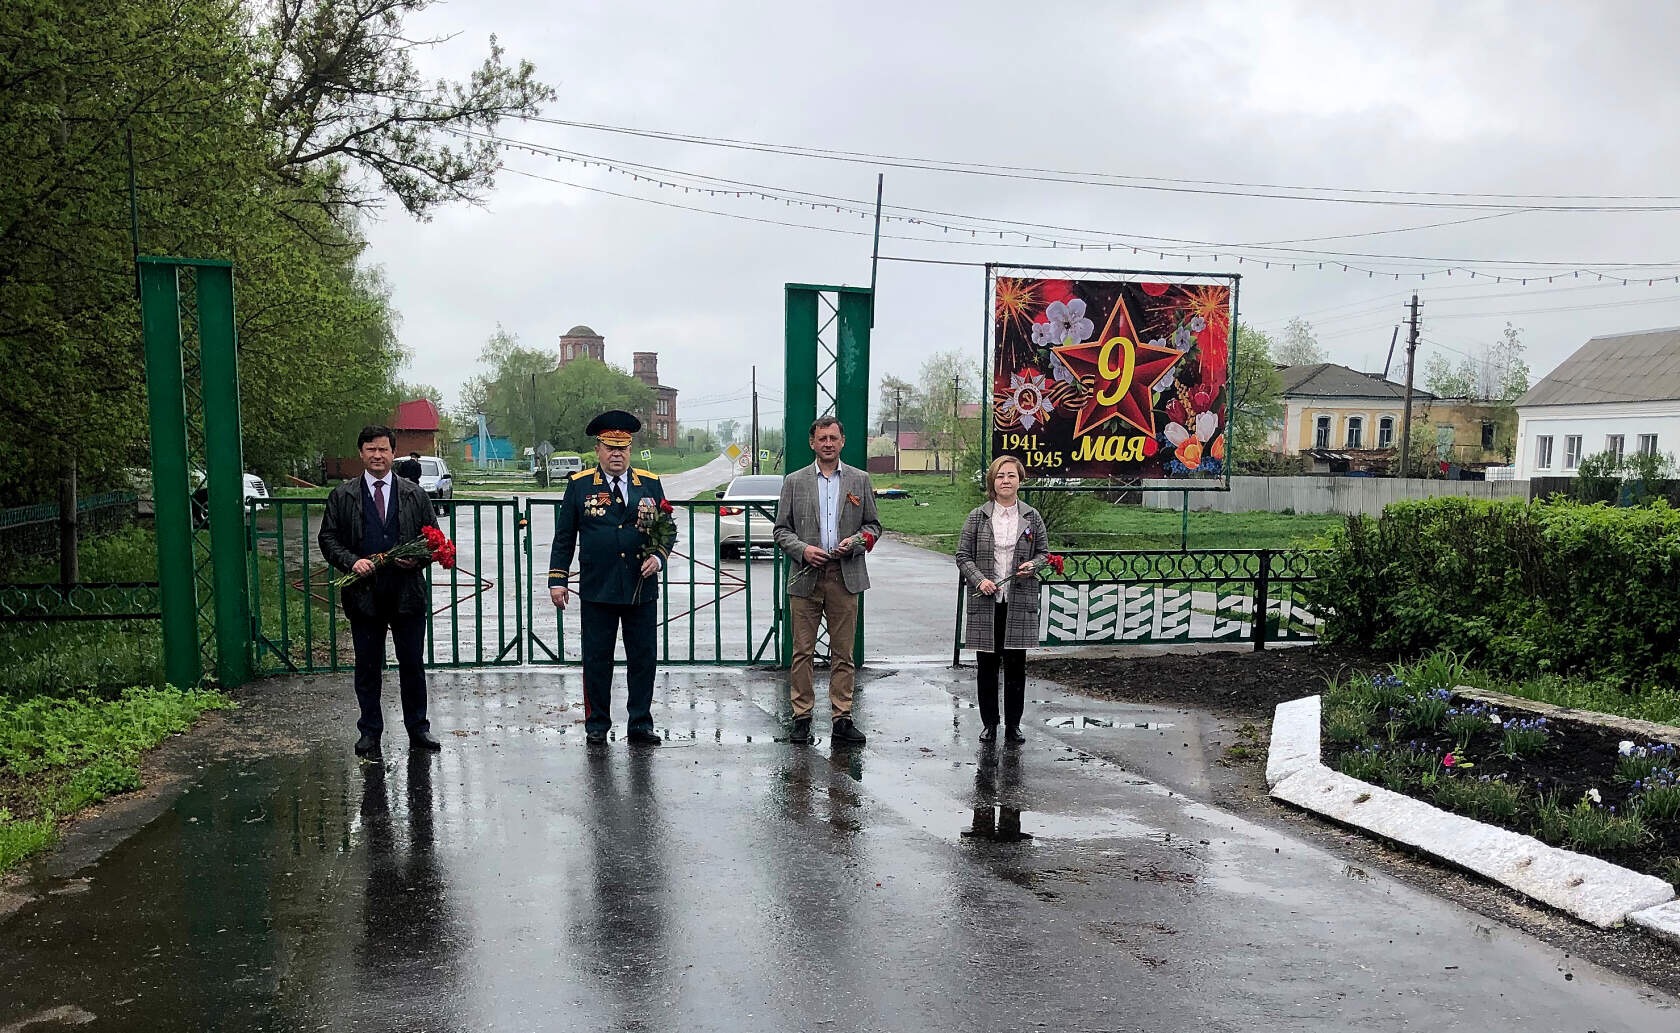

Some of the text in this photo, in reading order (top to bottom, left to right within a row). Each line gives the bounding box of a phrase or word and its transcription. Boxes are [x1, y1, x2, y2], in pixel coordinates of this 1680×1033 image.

[1096, 336, 1136, 406] 9
[1001, 433, 1046, 450] 1941-
[1071, 434, 1147, 462] мая
[1025, 451, 1063, 468] 1945
